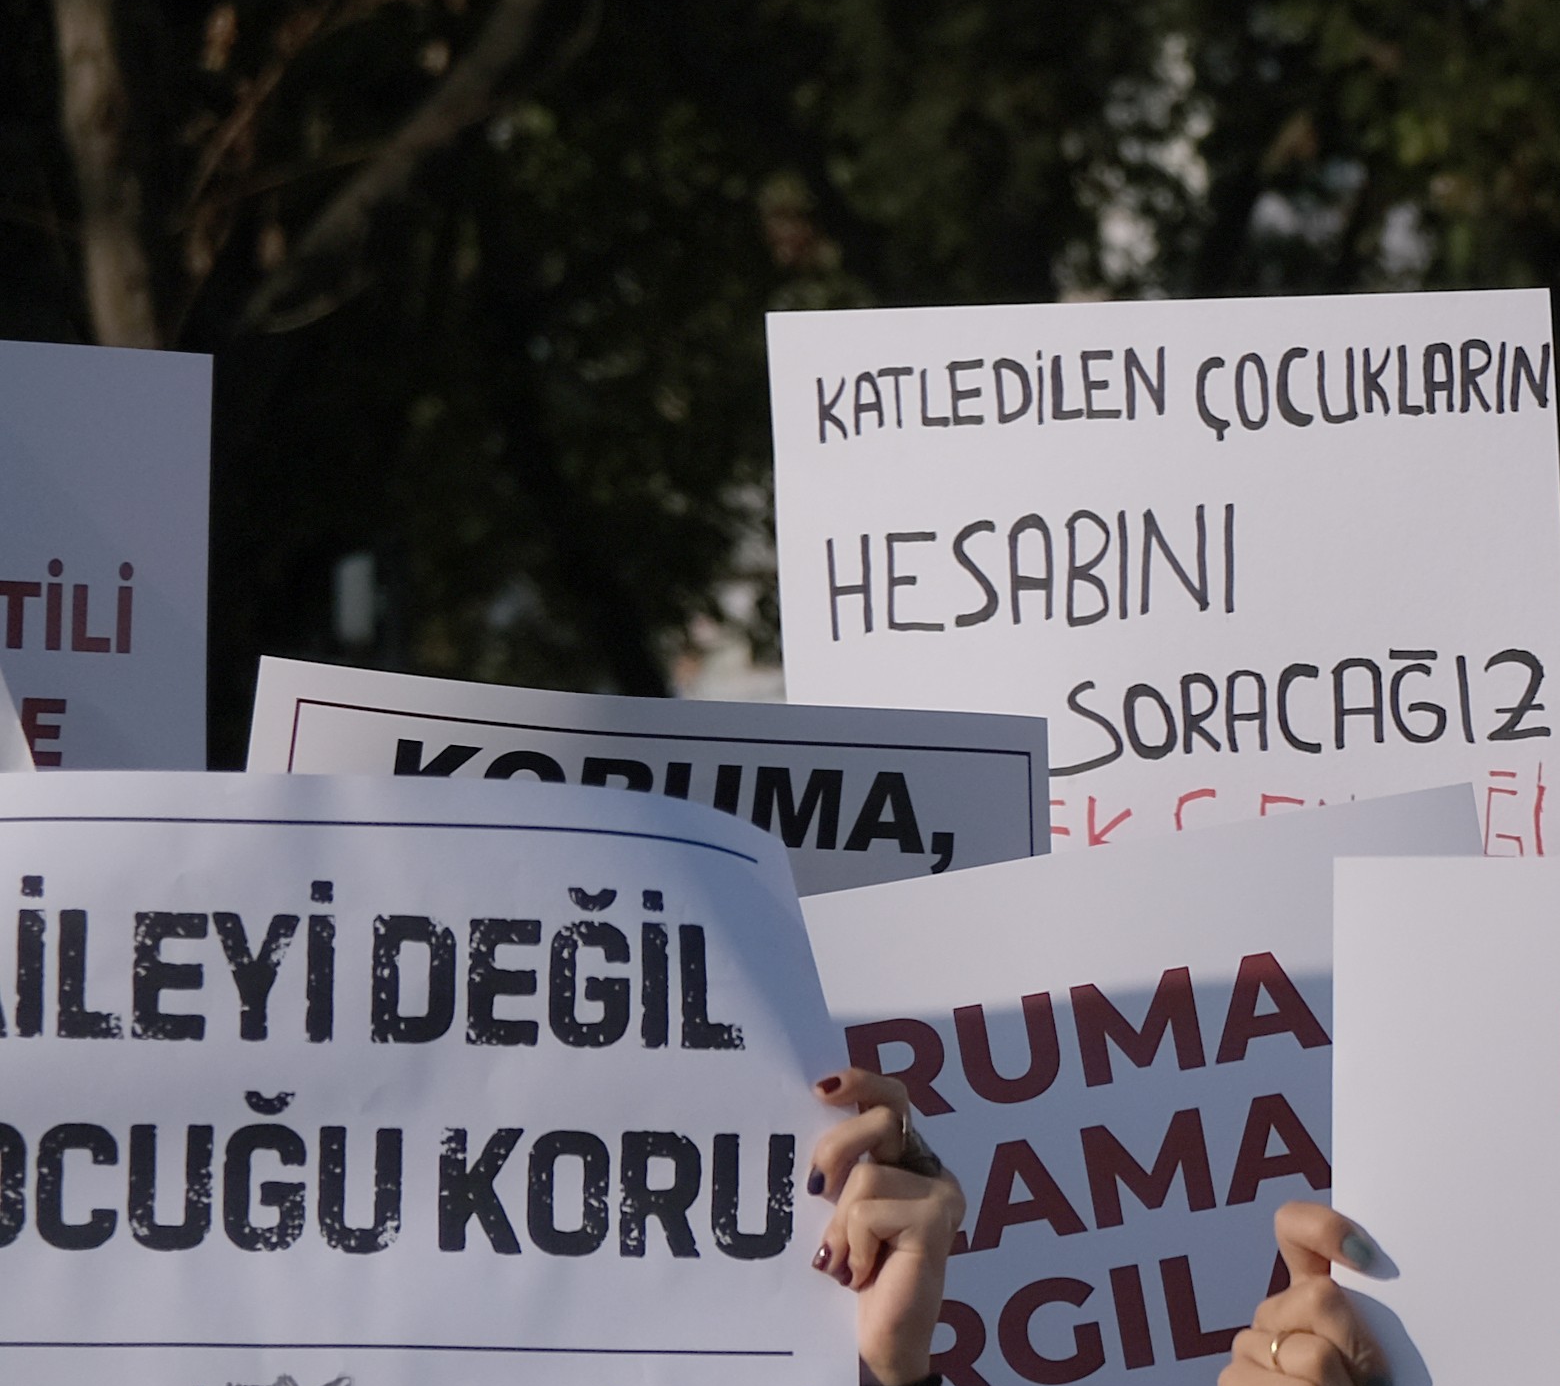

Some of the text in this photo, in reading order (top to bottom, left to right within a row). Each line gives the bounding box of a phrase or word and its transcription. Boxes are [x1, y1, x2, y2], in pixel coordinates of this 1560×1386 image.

[816, 338, 1552, 444] KATLEDİLEN ÇOCUKLARIN
[826, 503, 1236, 641] HESABINI
[1049, 648, 1552, 778] SORACAĞIZ
[0, 874, 746, 1051] İLEYİ DEĞİL
[437, 1126, 796, 1261] KORU
[948, 1092, 1332, 1257] AMA
